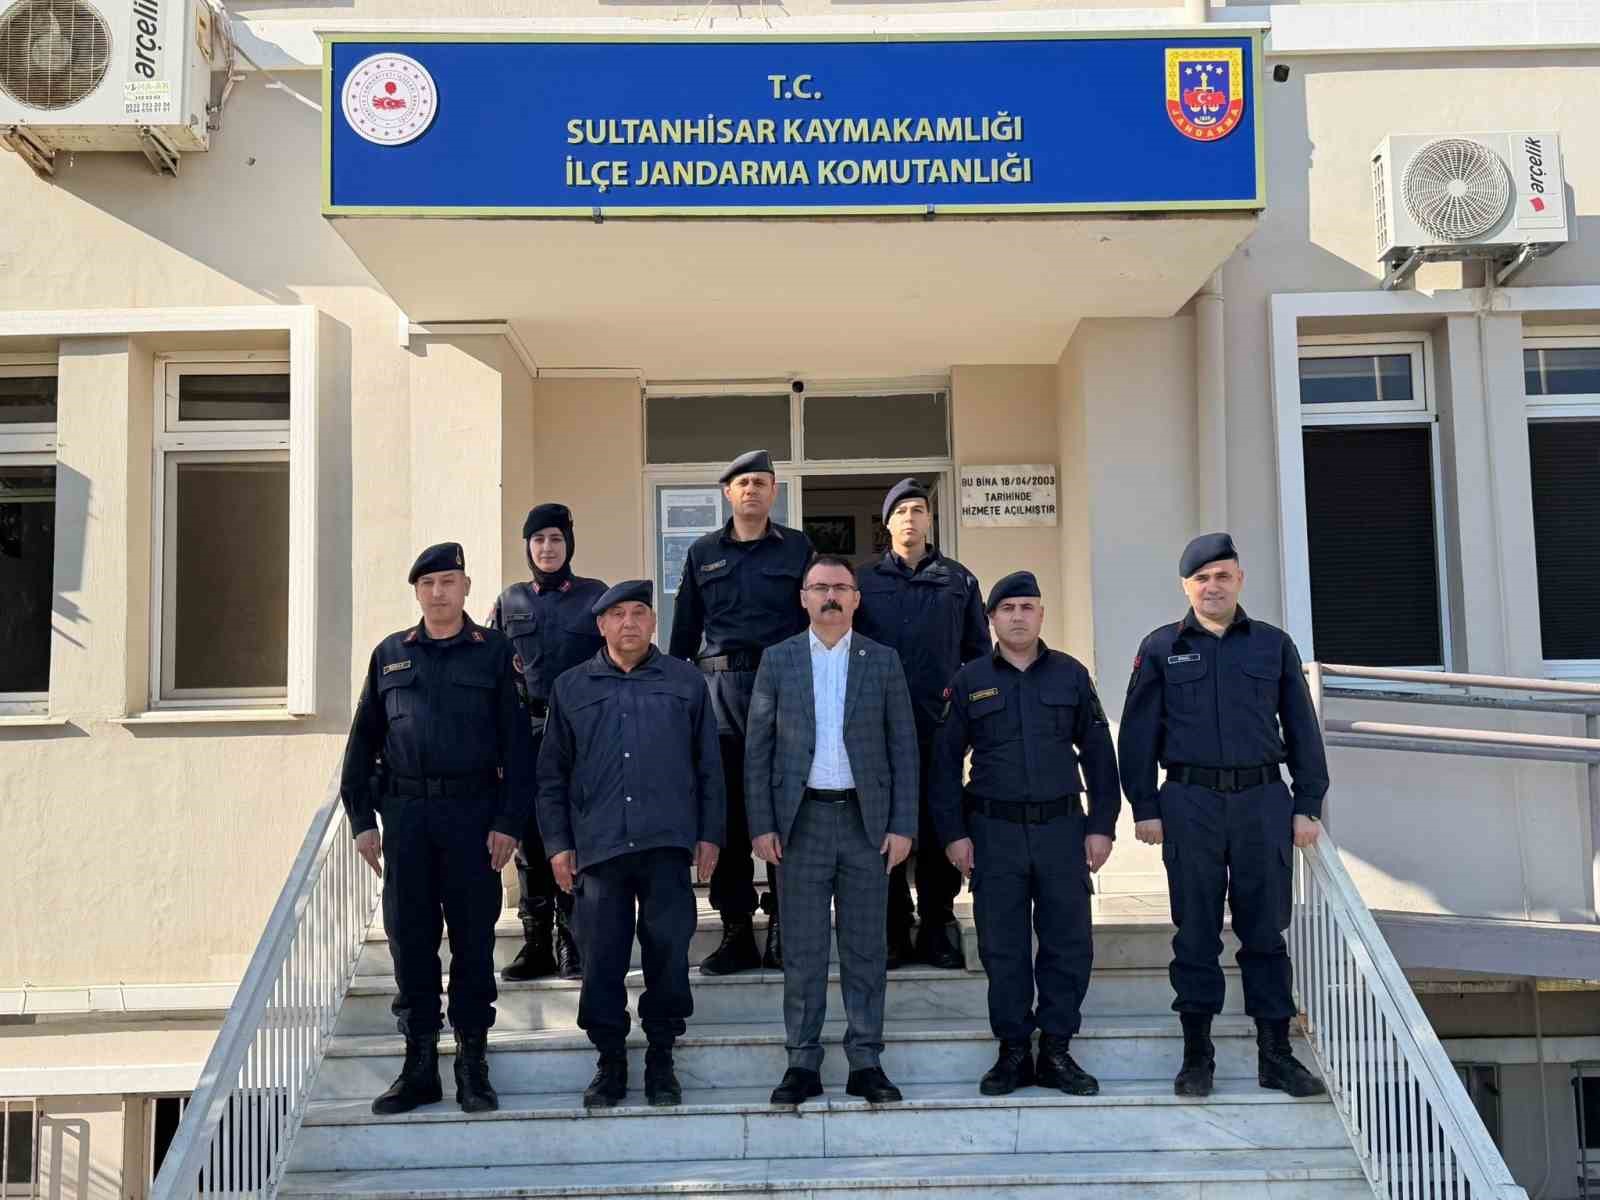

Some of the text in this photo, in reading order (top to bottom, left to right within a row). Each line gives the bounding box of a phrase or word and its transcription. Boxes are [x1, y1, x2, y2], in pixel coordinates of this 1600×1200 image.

[767, 74, 822, 99] T.C.
[567, 111, 1022, 144] SULTANHİSAR KAYMAKAMLIĞI
[566, 152, 1032, 192] İLÇE JANDARMA KOMUTANLIĞI
[1525, 136, 1546, 194] arçelik
[961, 478, 973, 487] BU
